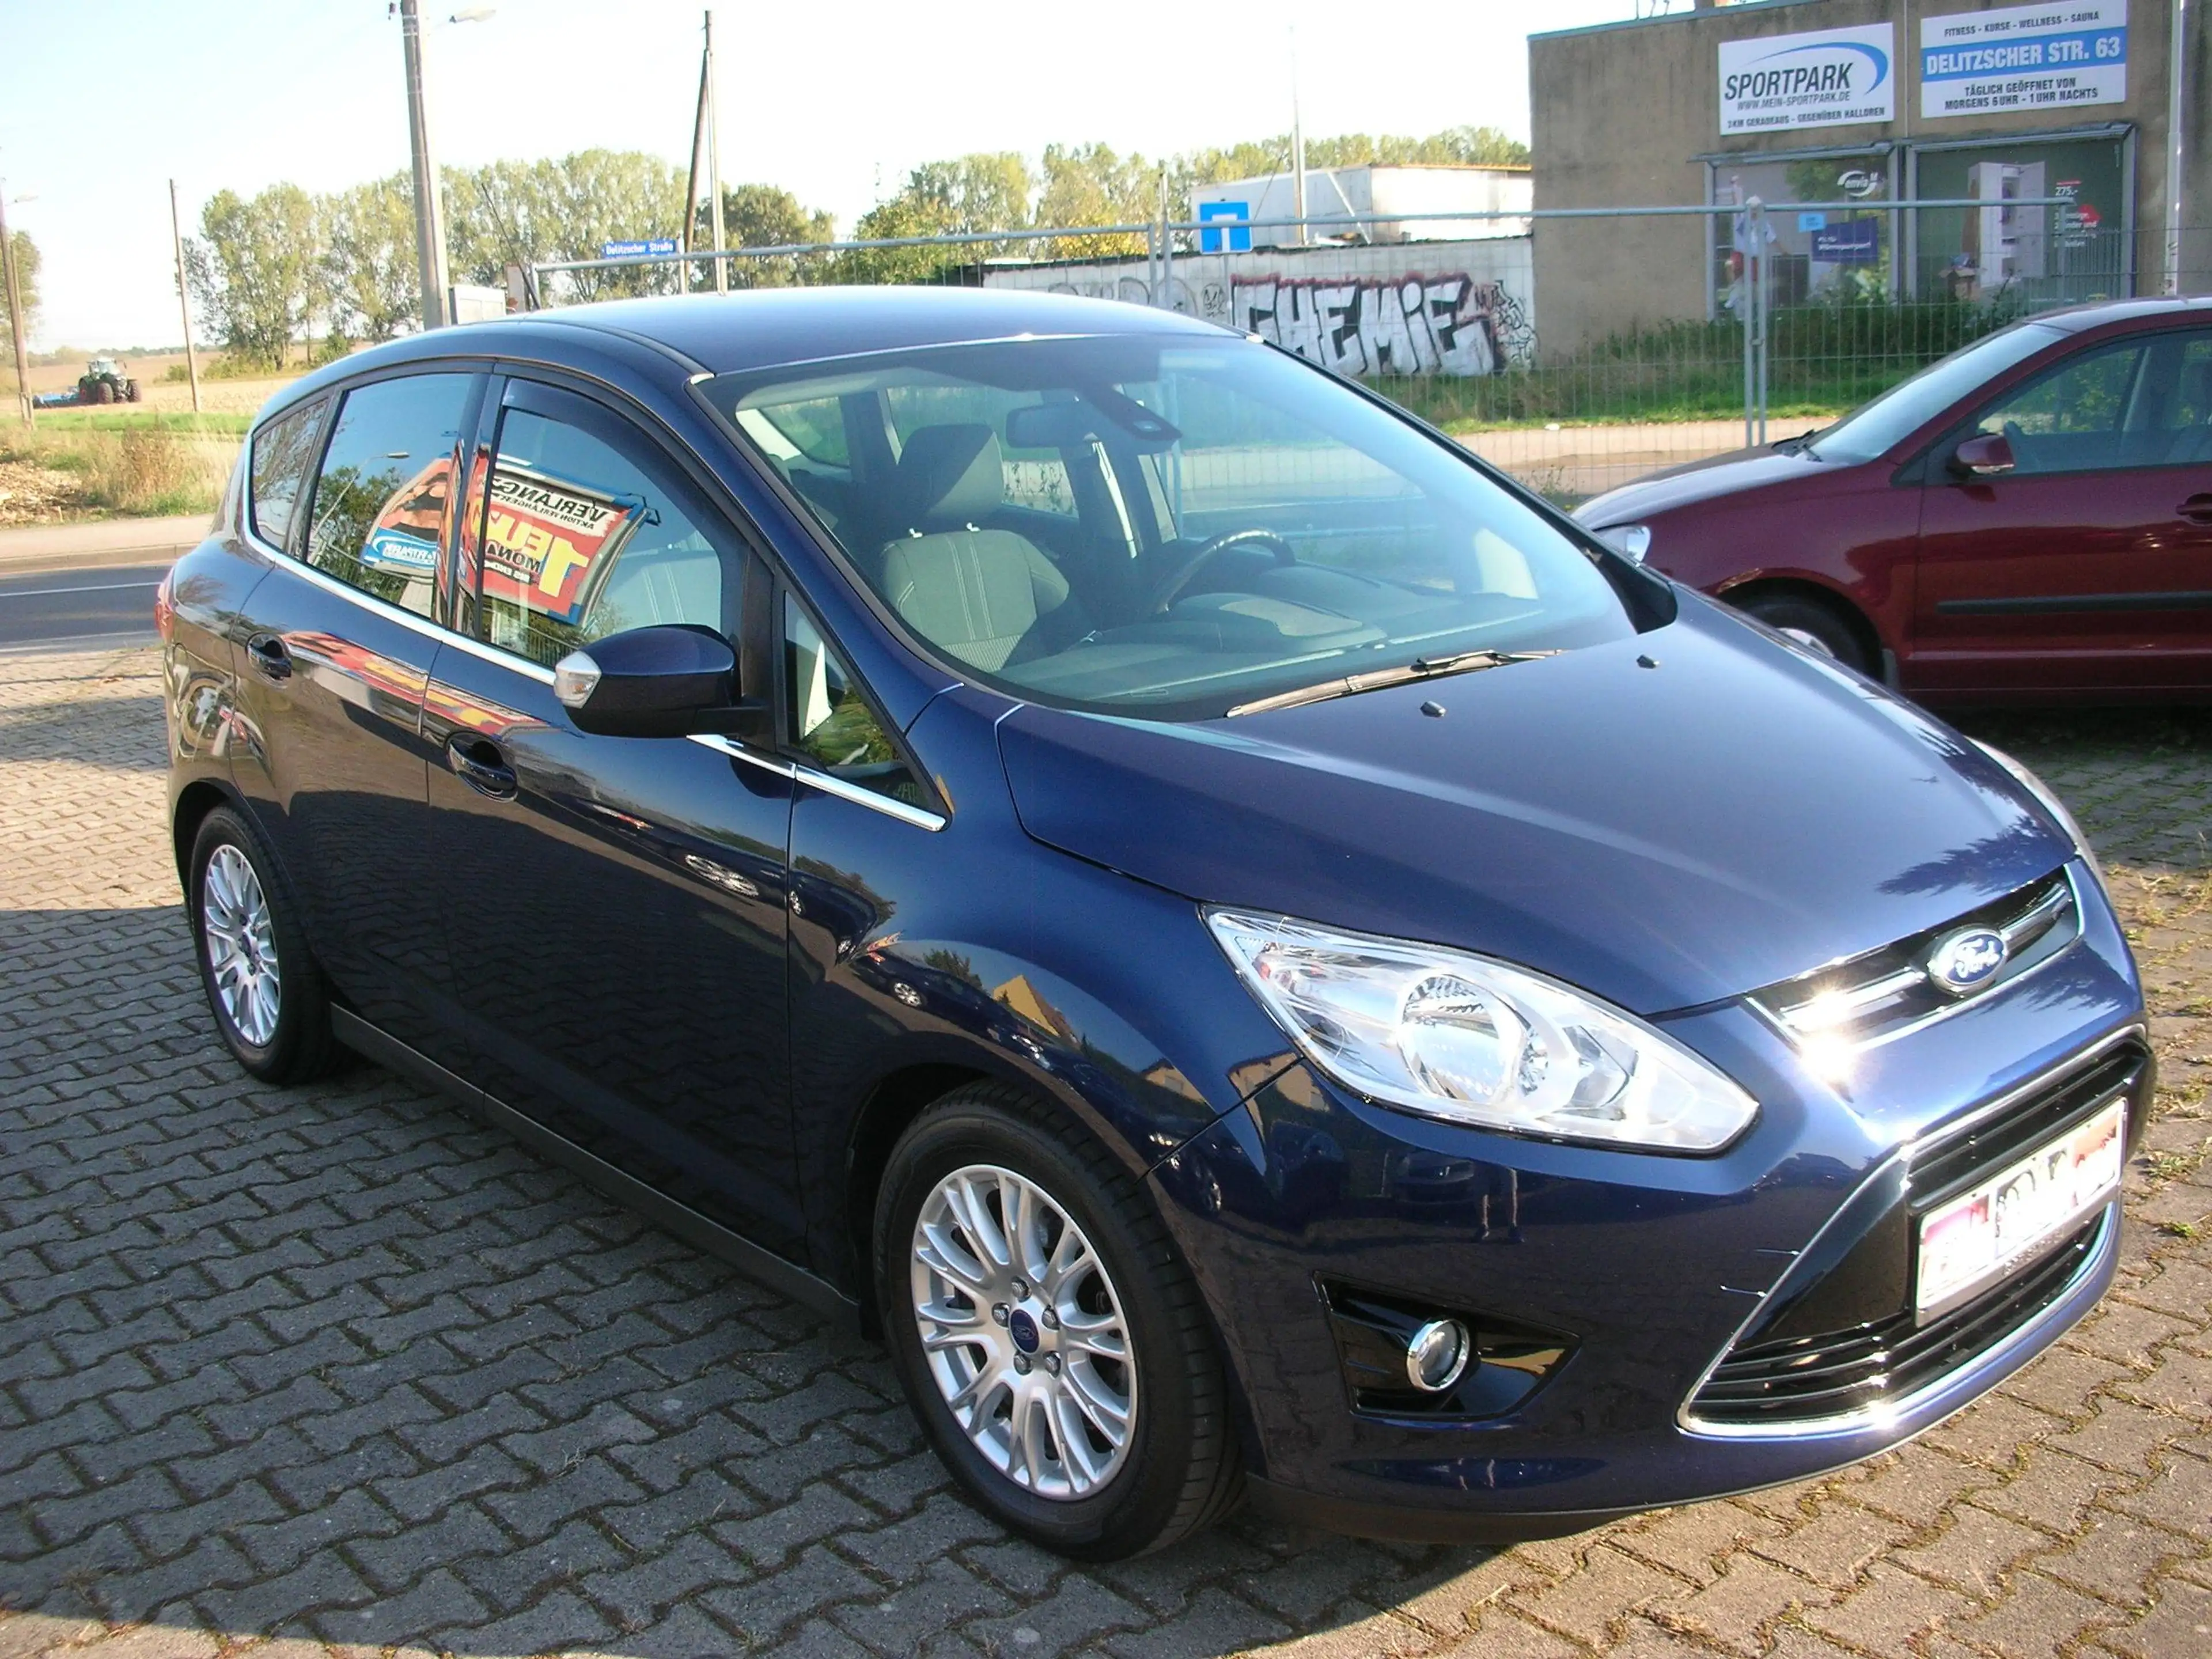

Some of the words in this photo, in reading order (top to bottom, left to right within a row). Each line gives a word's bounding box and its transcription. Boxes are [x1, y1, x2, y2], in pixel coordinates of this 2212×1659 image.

[1944, 27, 1976, 37] FITNESS
[1984, 21, 2010, 33] KURSE
[2018, 16, 2062, 28] WELLNESS
[2071, 11, 2100, 23] SAUNA
[1926, 44, 2043, 75] DELITZSCHER
[2048, 40, 2089, 63] STR.
[2095, 36, 2120, 58] 63
[1724, 62, 1854, 101] SPORTPARK
[1964, 81, 2003, 97] TÄGLICH
[2005, 78, 2054, 93] GEÖFFNET
[2056, 77, 2077, 89] VON
[1737, 90, 1851, 112] WWW.MEIN-SPORTPARK.DE
[1944, 97, 1990, 110] MORGENS
[1999, 94, 2018, 106] UHR
[2036, 90, 2056, 103] UHR
[2058, 88, 2099, 100] NACHTS
[1797, 109, 1842, 123] GEGENÜBER
[605, 243, 646, 256] Delitzscher
